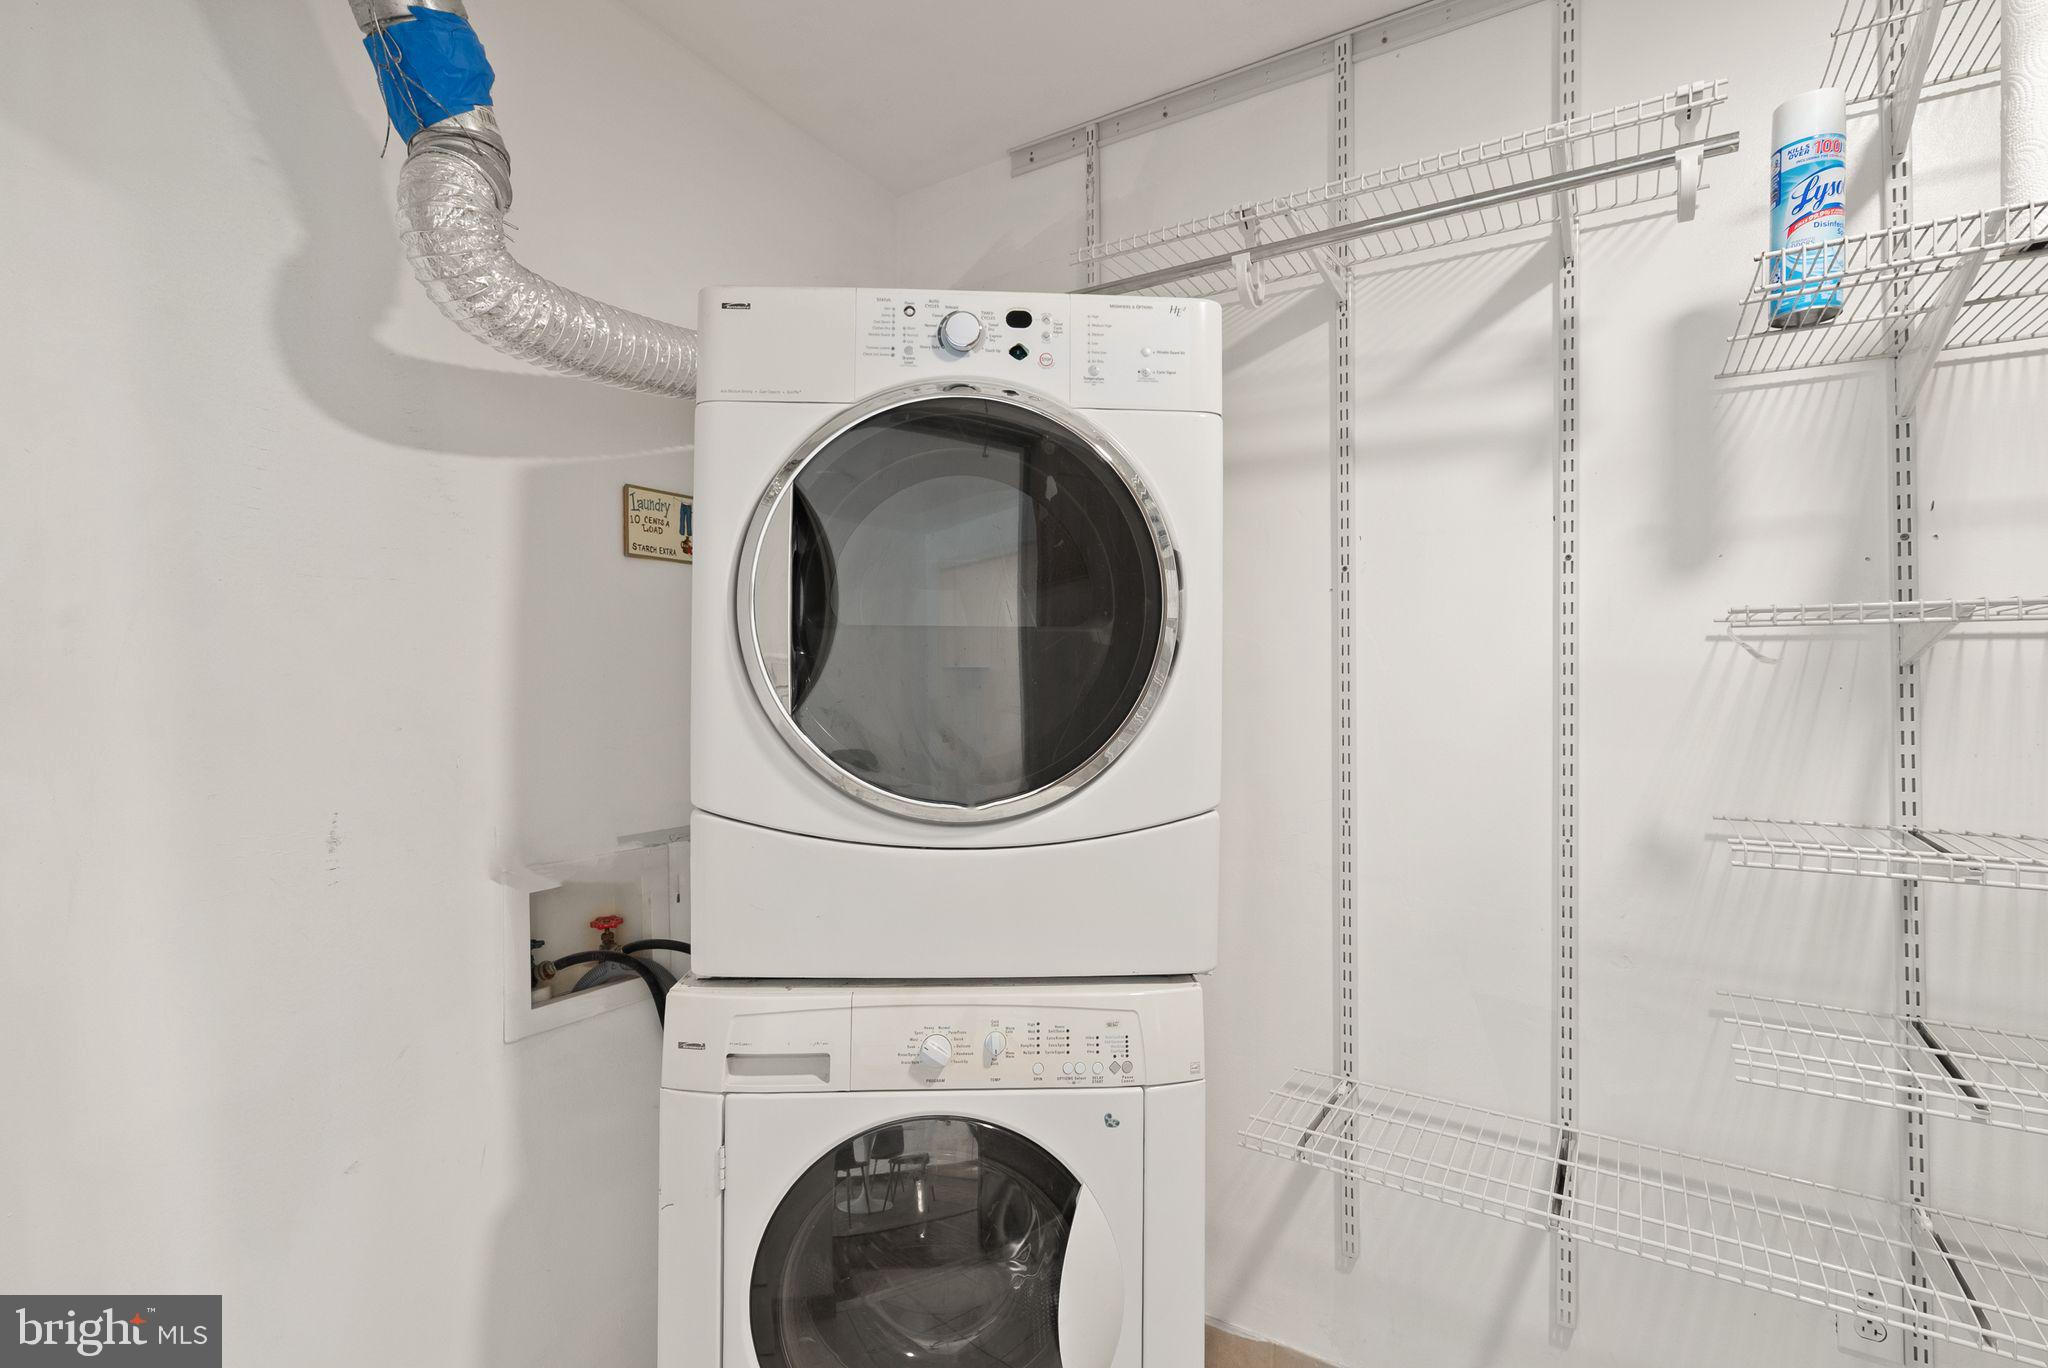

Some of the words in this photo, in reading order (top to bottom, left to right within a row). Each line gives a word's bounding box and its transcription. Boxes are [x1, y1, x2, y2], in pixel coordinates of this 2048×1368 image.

[1787, 143, 1810, 155] KILLS
[1815, 139, 1842, 154] 100
[1788, 149, 1810, 160] OVER
[630, 492, 671, 518] Laundry
[630, 515, 641, 524] 10
[643, 516, 665, 527] CENTS
[642, 524, 664, 535] LOAD
[632, 542, 657, 554] STARCH
[659, 547, 677, 557] EXTRA
